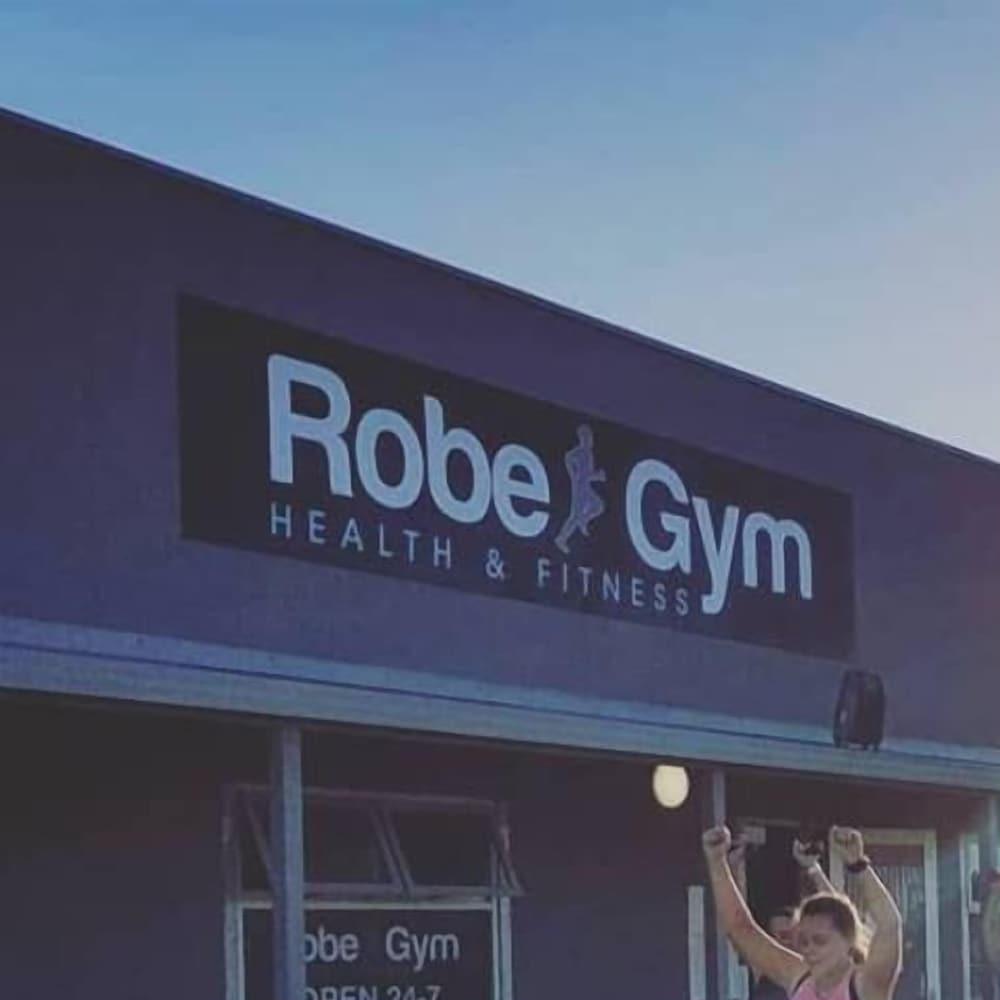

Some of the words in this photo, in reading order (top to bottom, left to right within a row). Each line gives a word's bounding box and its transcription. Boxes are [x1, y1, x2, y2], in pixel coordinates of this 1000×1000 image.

[267, 353, 550, 538] Robe
[625, 458, 813, 615] Gym
[270, 502, 452, 569] HEALTH
[485, 548, 505, 580] &
[537, 557, 690, 616] FITNESS
[303, 925, 360, 962] obe
[385, 925, 461, 973] Gym
